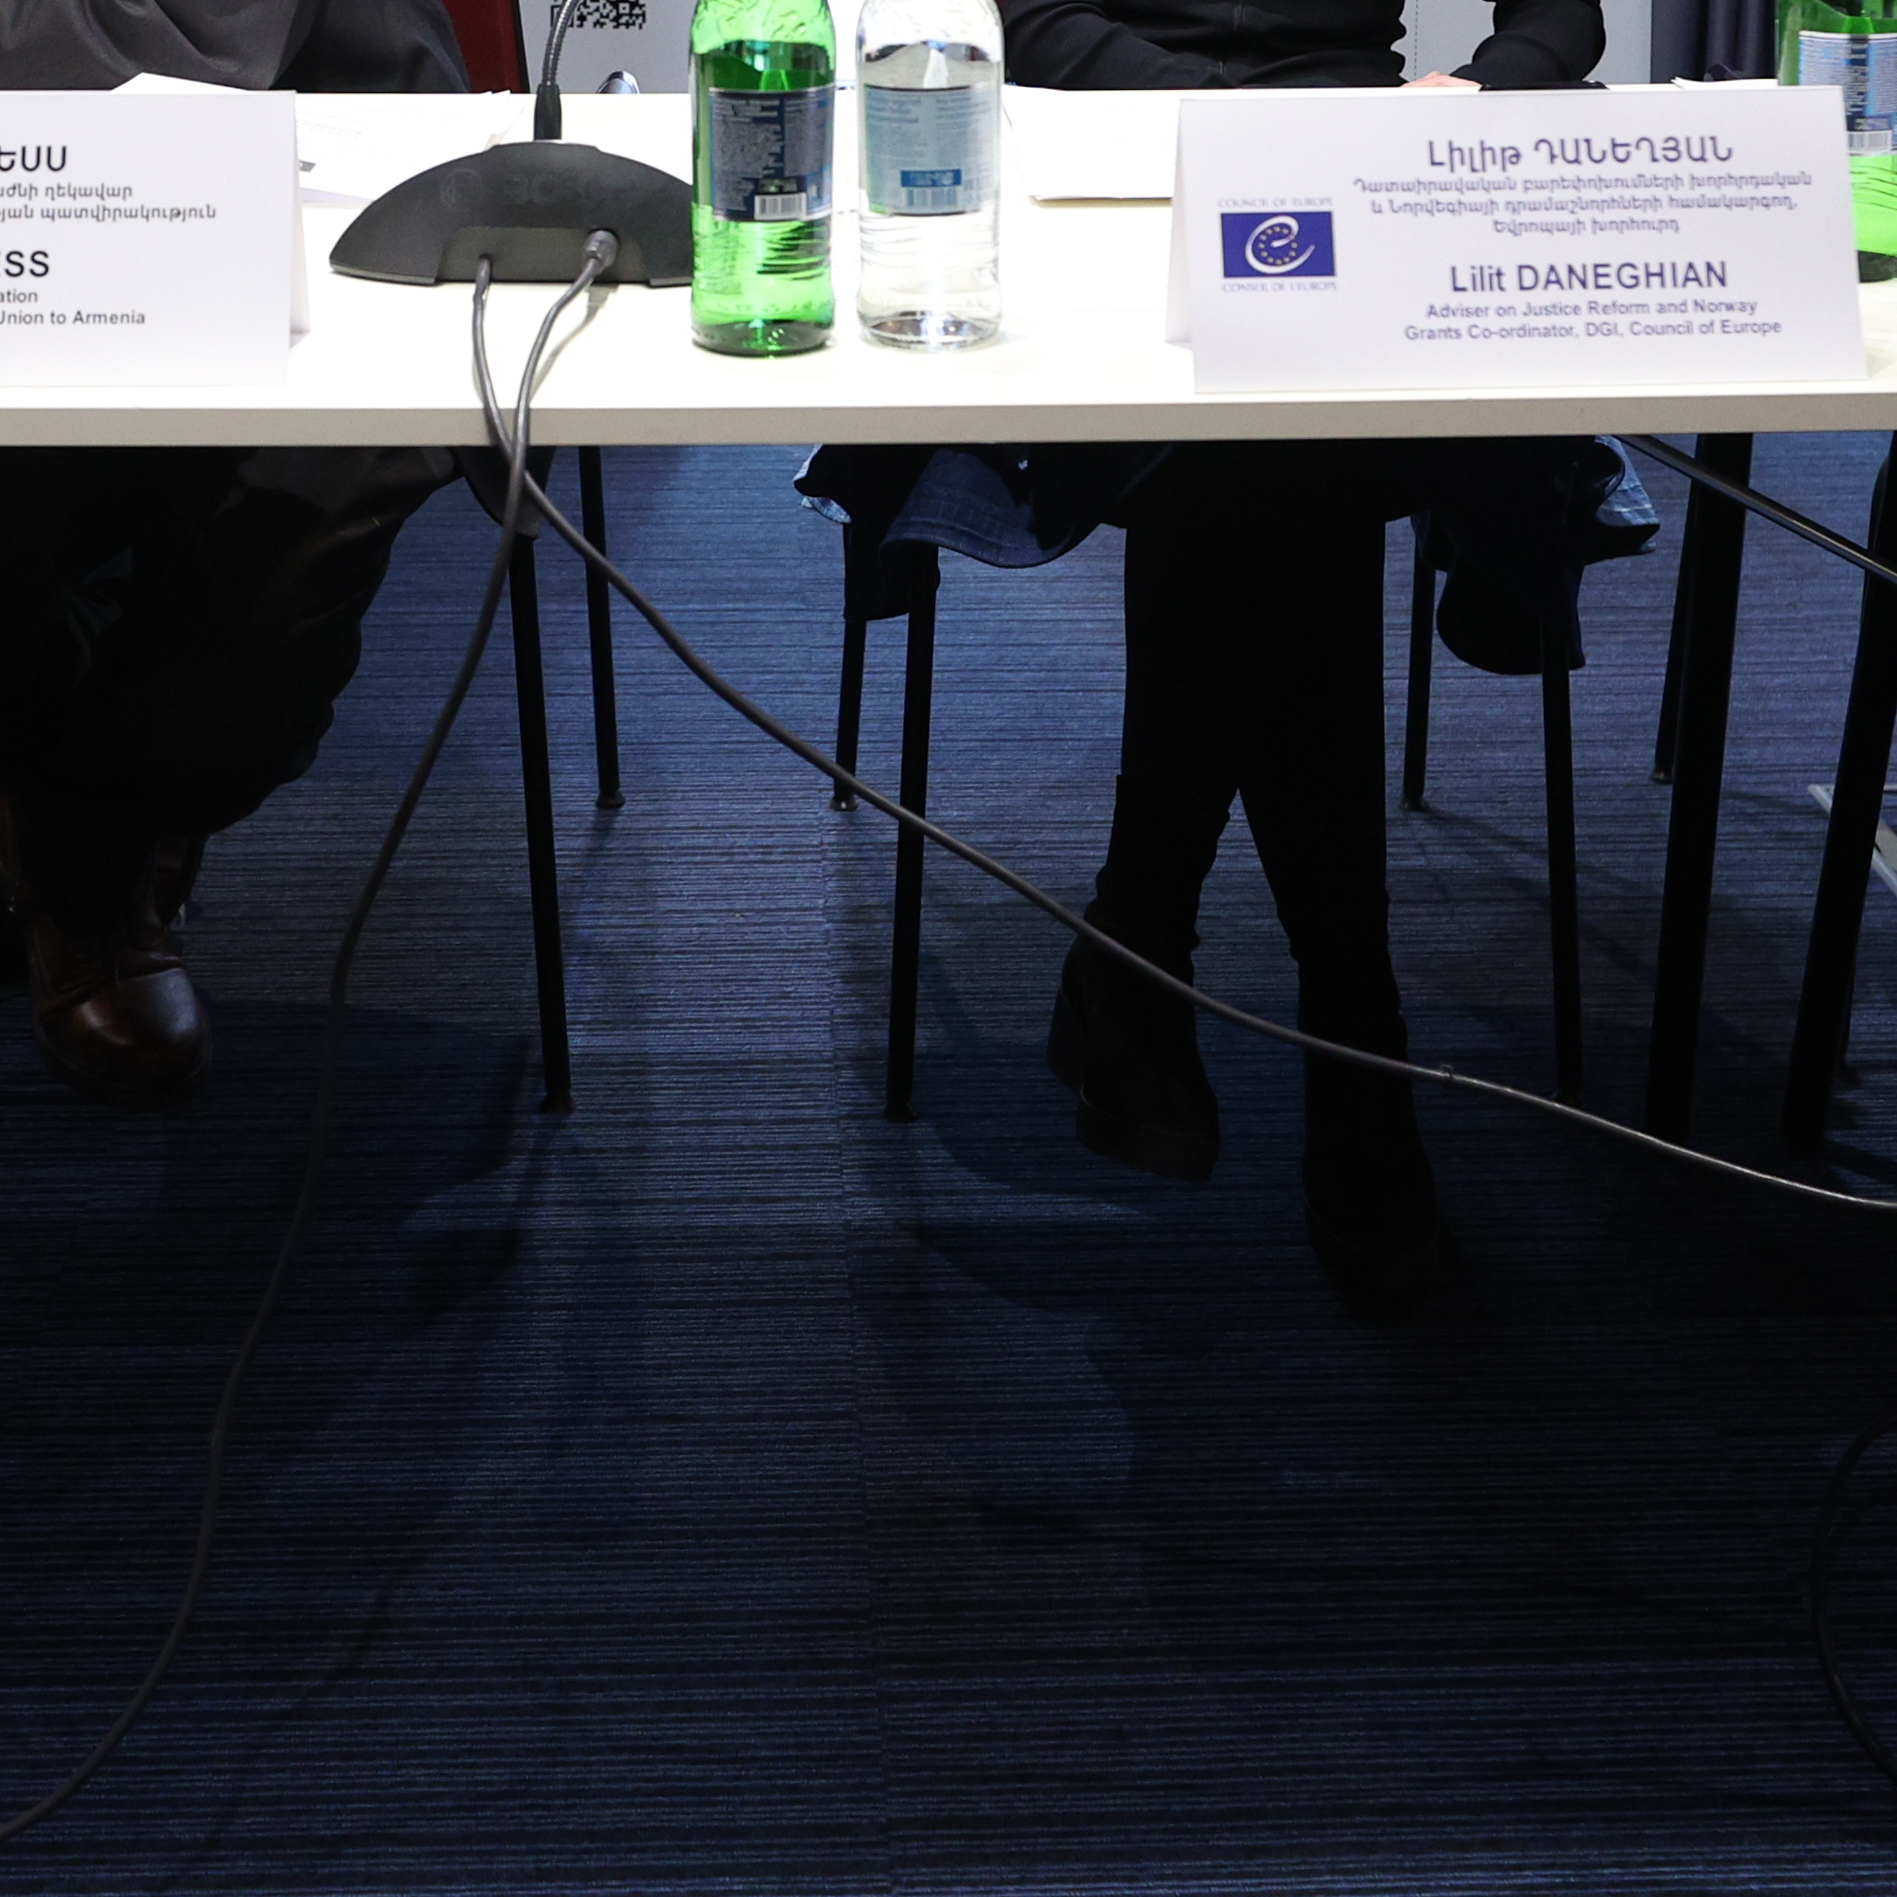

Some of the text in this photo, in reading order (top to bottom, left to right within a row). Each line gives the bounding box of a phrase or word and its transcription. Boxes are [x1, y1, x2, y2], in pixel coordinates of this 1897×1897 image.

[1428, 135, 1734, 173] Լիլիթ ԴԱՆԵՂՅԱՆ
[44, 183, 133, 201] ղեկավար
[40, 204, 216, 223] պատվիրակություն
[1450, 260, 1729, 293] Lilit DANEGHIAN
[50, 312, 67, 325] to
[72, 310, 146, 325] Armenia
[1426, 299, 1758, 319] Adviser on Justice Reform and Norway
[1405, 324, 1463, 341] Grants
[1467, 323, 1579, 340] Co-ordinator,
[1628, 320, 1694, 337] Council
[1698, 320, 1716, 335] of
[1720, 320, 1782, 338] Europe
